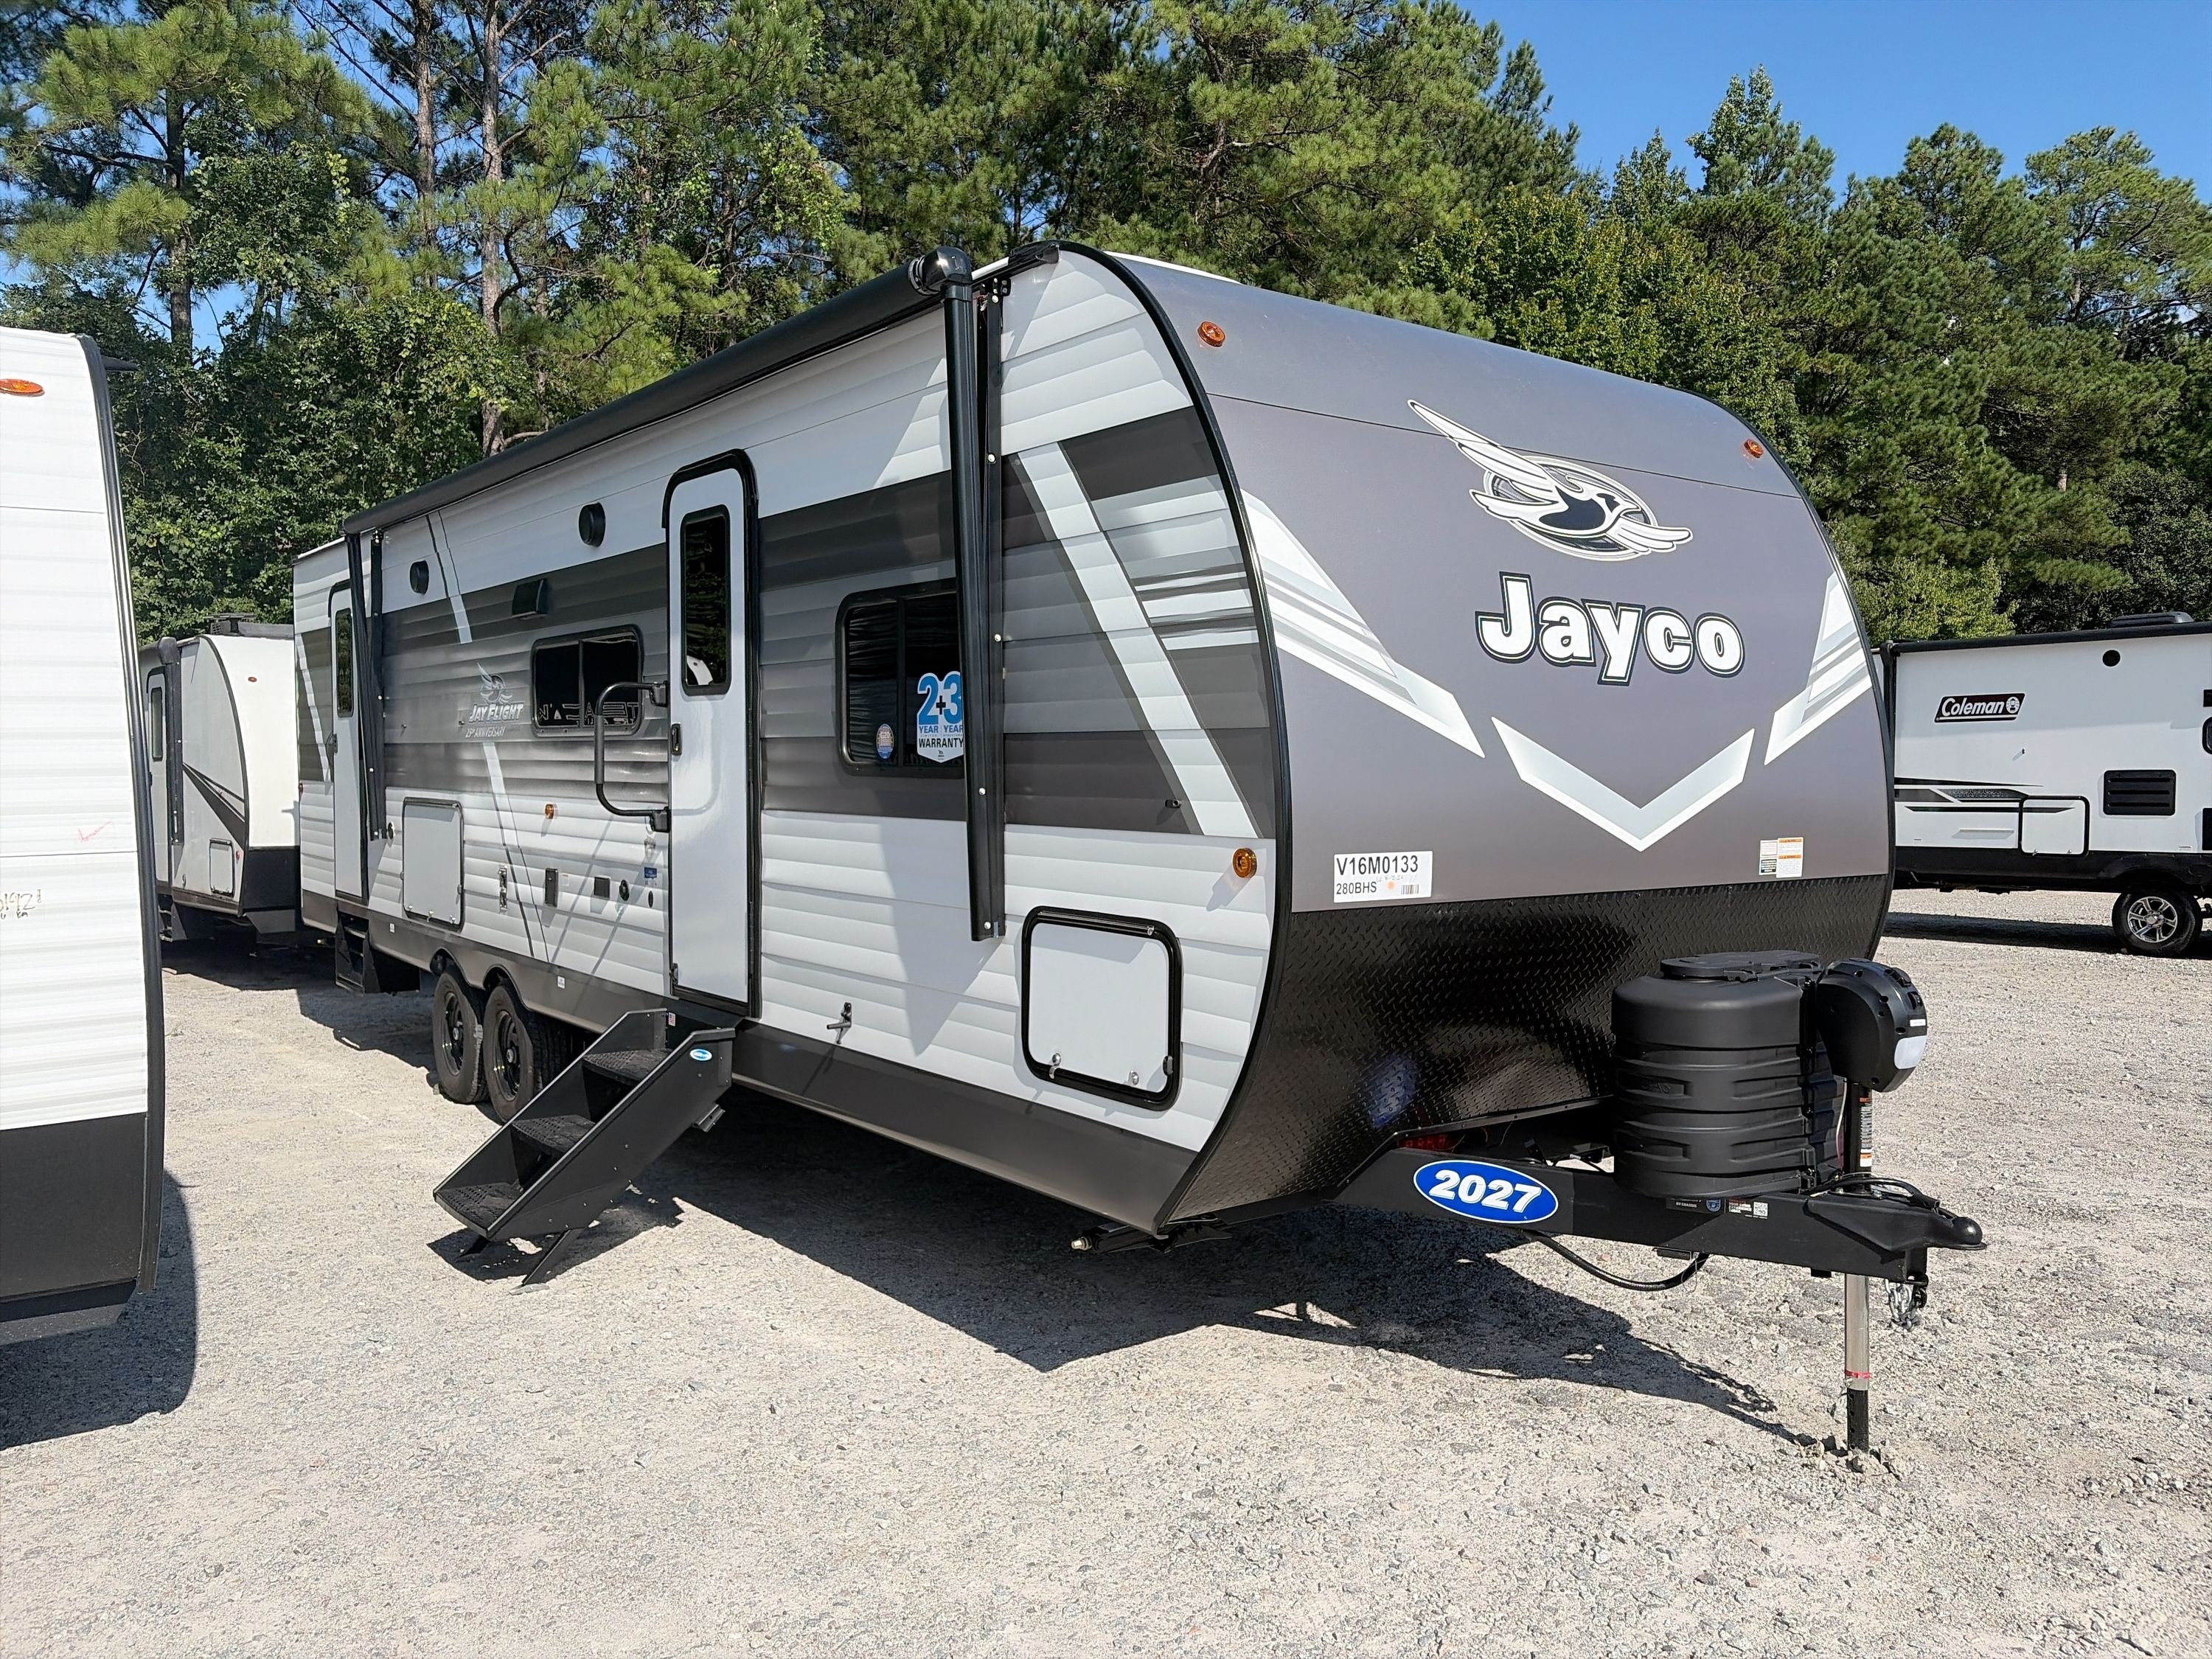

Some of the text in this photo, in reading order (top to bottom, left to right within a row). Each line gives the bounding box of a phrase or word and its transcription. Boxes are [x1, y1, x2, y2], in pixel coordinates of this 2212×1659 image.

[1475, 571, 1745, 686] Jayco
[469, 704, 488, 723] JAY
[487, 703, 524, 721] FLIGHT
[1941, 698, 2005, 717] Coleman
[919, 726, 939, 734] YEAR
[918, 738, 964, 748] WARRANTY
[1336, 855, 1419, 876] V16M0133
[1336, 881, 1377, 894] 280BHS
[1428, 1169, 1543, 1213] 2027
